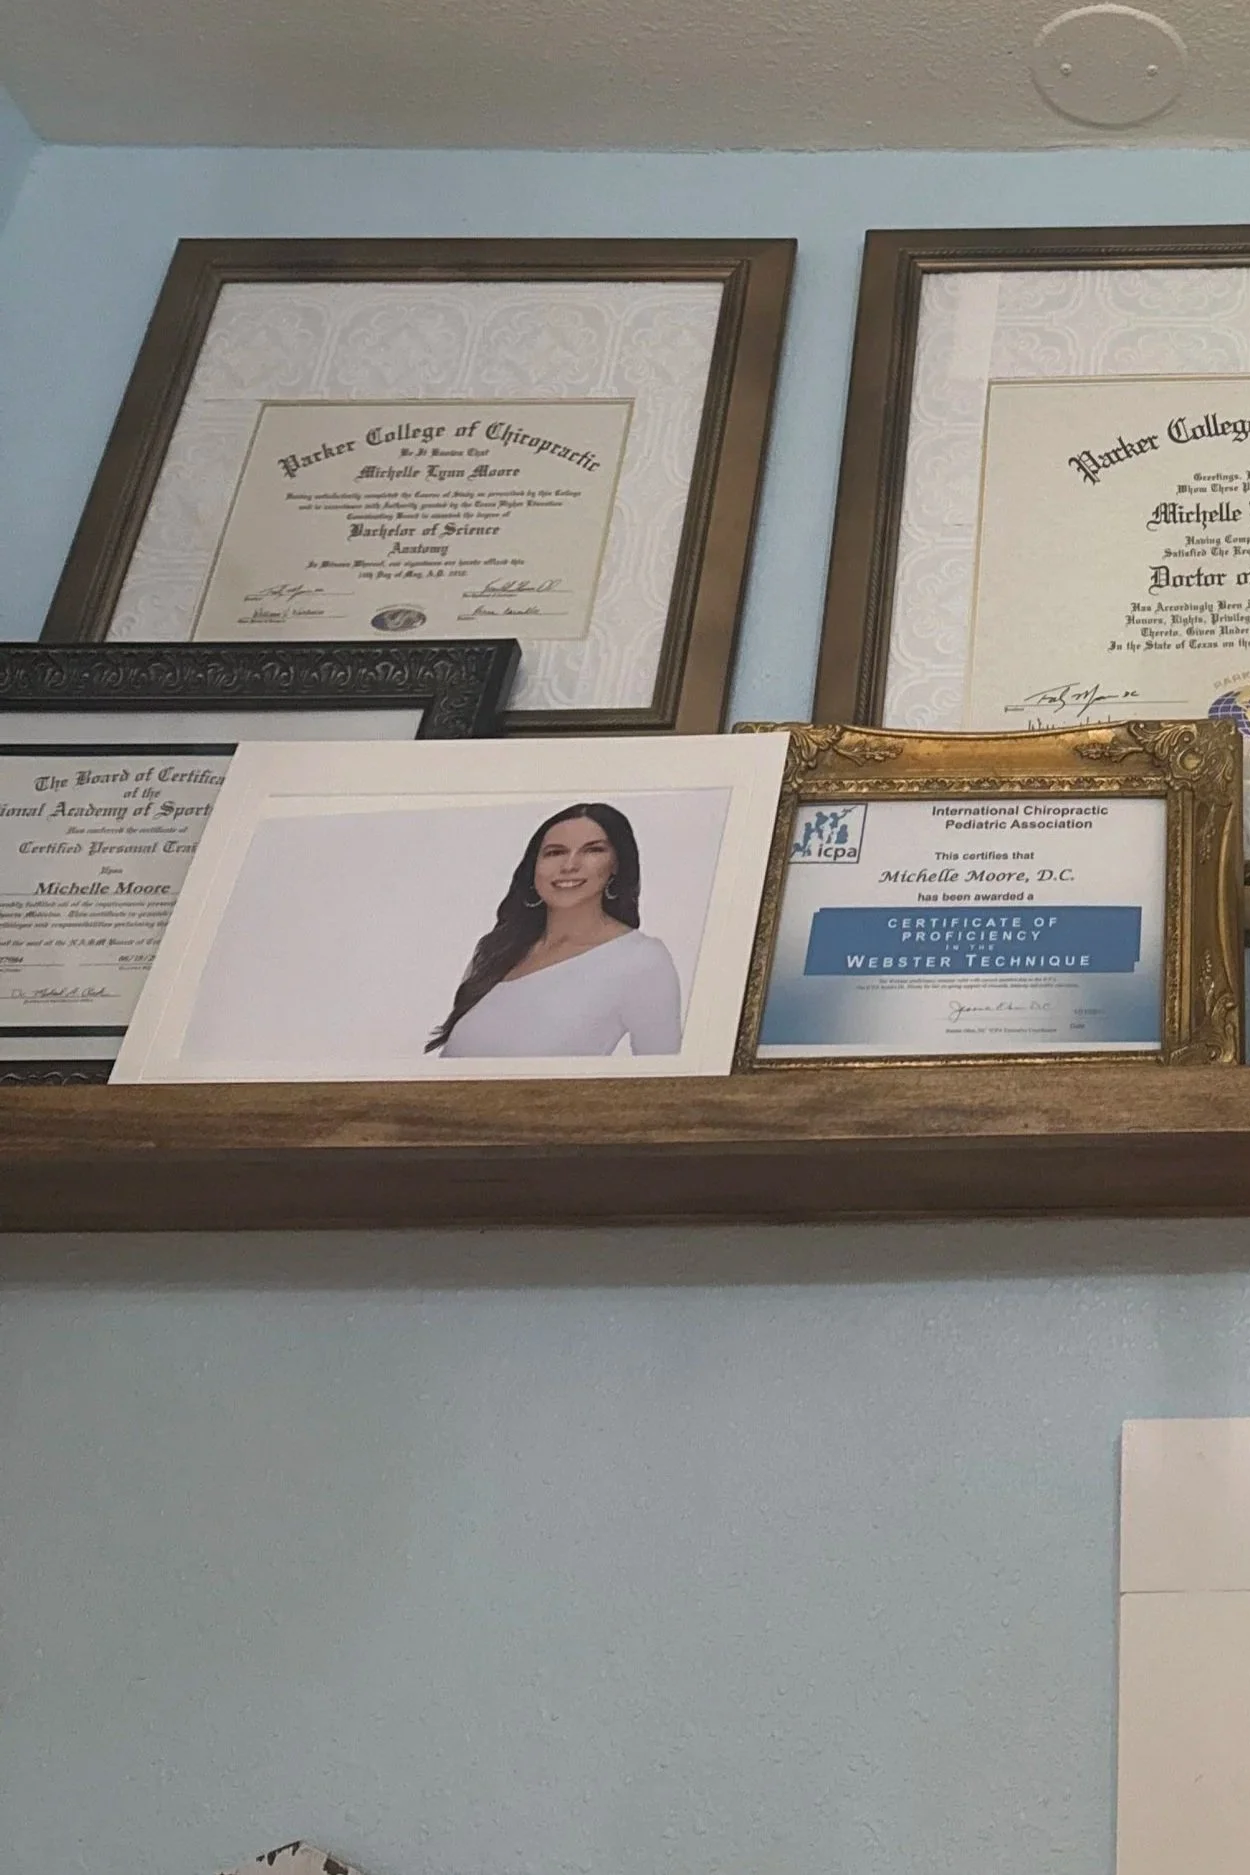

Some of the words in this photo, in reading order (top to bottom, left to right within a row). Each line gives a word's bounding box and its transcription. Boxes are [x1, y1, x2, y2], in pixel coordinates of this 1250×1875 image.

[277, 441, 356, 479] Parker
[366, 423, 445, 446] College
[455, 421, 481, 437] of
[486, 422, 600, 472] Chiropractic
[1068, 435, 1160, 485] Parker
[354, 465, 420, 482] Michelle
[425, 465, 465, 480] Lynn
[467, 465, 520, 481] Moore
[1177, 485, 1207, 495] Whom
[1211, 484, 1238, 494] These
[1146, 502, 1242, 531] Michelle
[348, 523, 416, 540] Bachelor
[422, 522, 439, 536] of
[439, 523, 500, 538] Science
[1185, 535, 1221, 546] Having
[388, 542, 449, 556] Anatomy
[1163, 548, 1206, 558] Satisfied
[1211, 548, 1229, 557] The
[1148, 565, 1227, 595] Doctor
[1131, 603, 1151, 612] Has
[1155, 602, 1213, 613] Accordingly
[1217, 601, 1242, 610] Been
[1186, 627, 1215, 636] Given
[1219, 626, 1249, 635] Under
[1107, 641, 1122, 652] In
[1127, 641, 1141, 652] the
[1144, 641, 1171, 651] State
[1175, 640, 1185, 649] of
[1189, 639, 1218, 649] Texas
[35, 776, 68, 792] The
[76, 770, 130, 787] Board
[135, 767, 156, 781] of
[123, 789, 138, 798] of
[142, 787, 161, 800] the
[48, 802, 128, 821] Academy
[133, 802, 150, 817] of
[932, 806, 1019, 817] International
[1023, 805, 1108, 817] Chiropractic
[945, 819, 1007, 829] Pediatric
[1010, 819, 1092, 829] Association
[19, 841, 82, 854] Certified
[88, 841, 156, 855] Personal
[817, 844, 857, 861] icpa
[935, 852, 959, 860] This
[962, 851, 1008, 860] certifies
[1012, 851, 1034, 860] that
[878, 868, 959, 883] Michelle
[965, 870, 1029, 883] Moore,
[1037, 869, 1075, 881] D.C.
[33, 883, 110, 895] Michelle
[115, 882, 171, 895] Moore
[918, 892, 938, 901] has
[943, 892, 970, 901] been
[974, 892, 1024, 901] awarded
[887, 917, 1022, 929] CERTIFICATE
[1033, 917, 1058, 927] OF
[902, 930, 1042, 942] PROFICIENCY
[846, 955, 951, 969] WEBSTER
[966, 954, 1090, 967] TECHNIQUE
